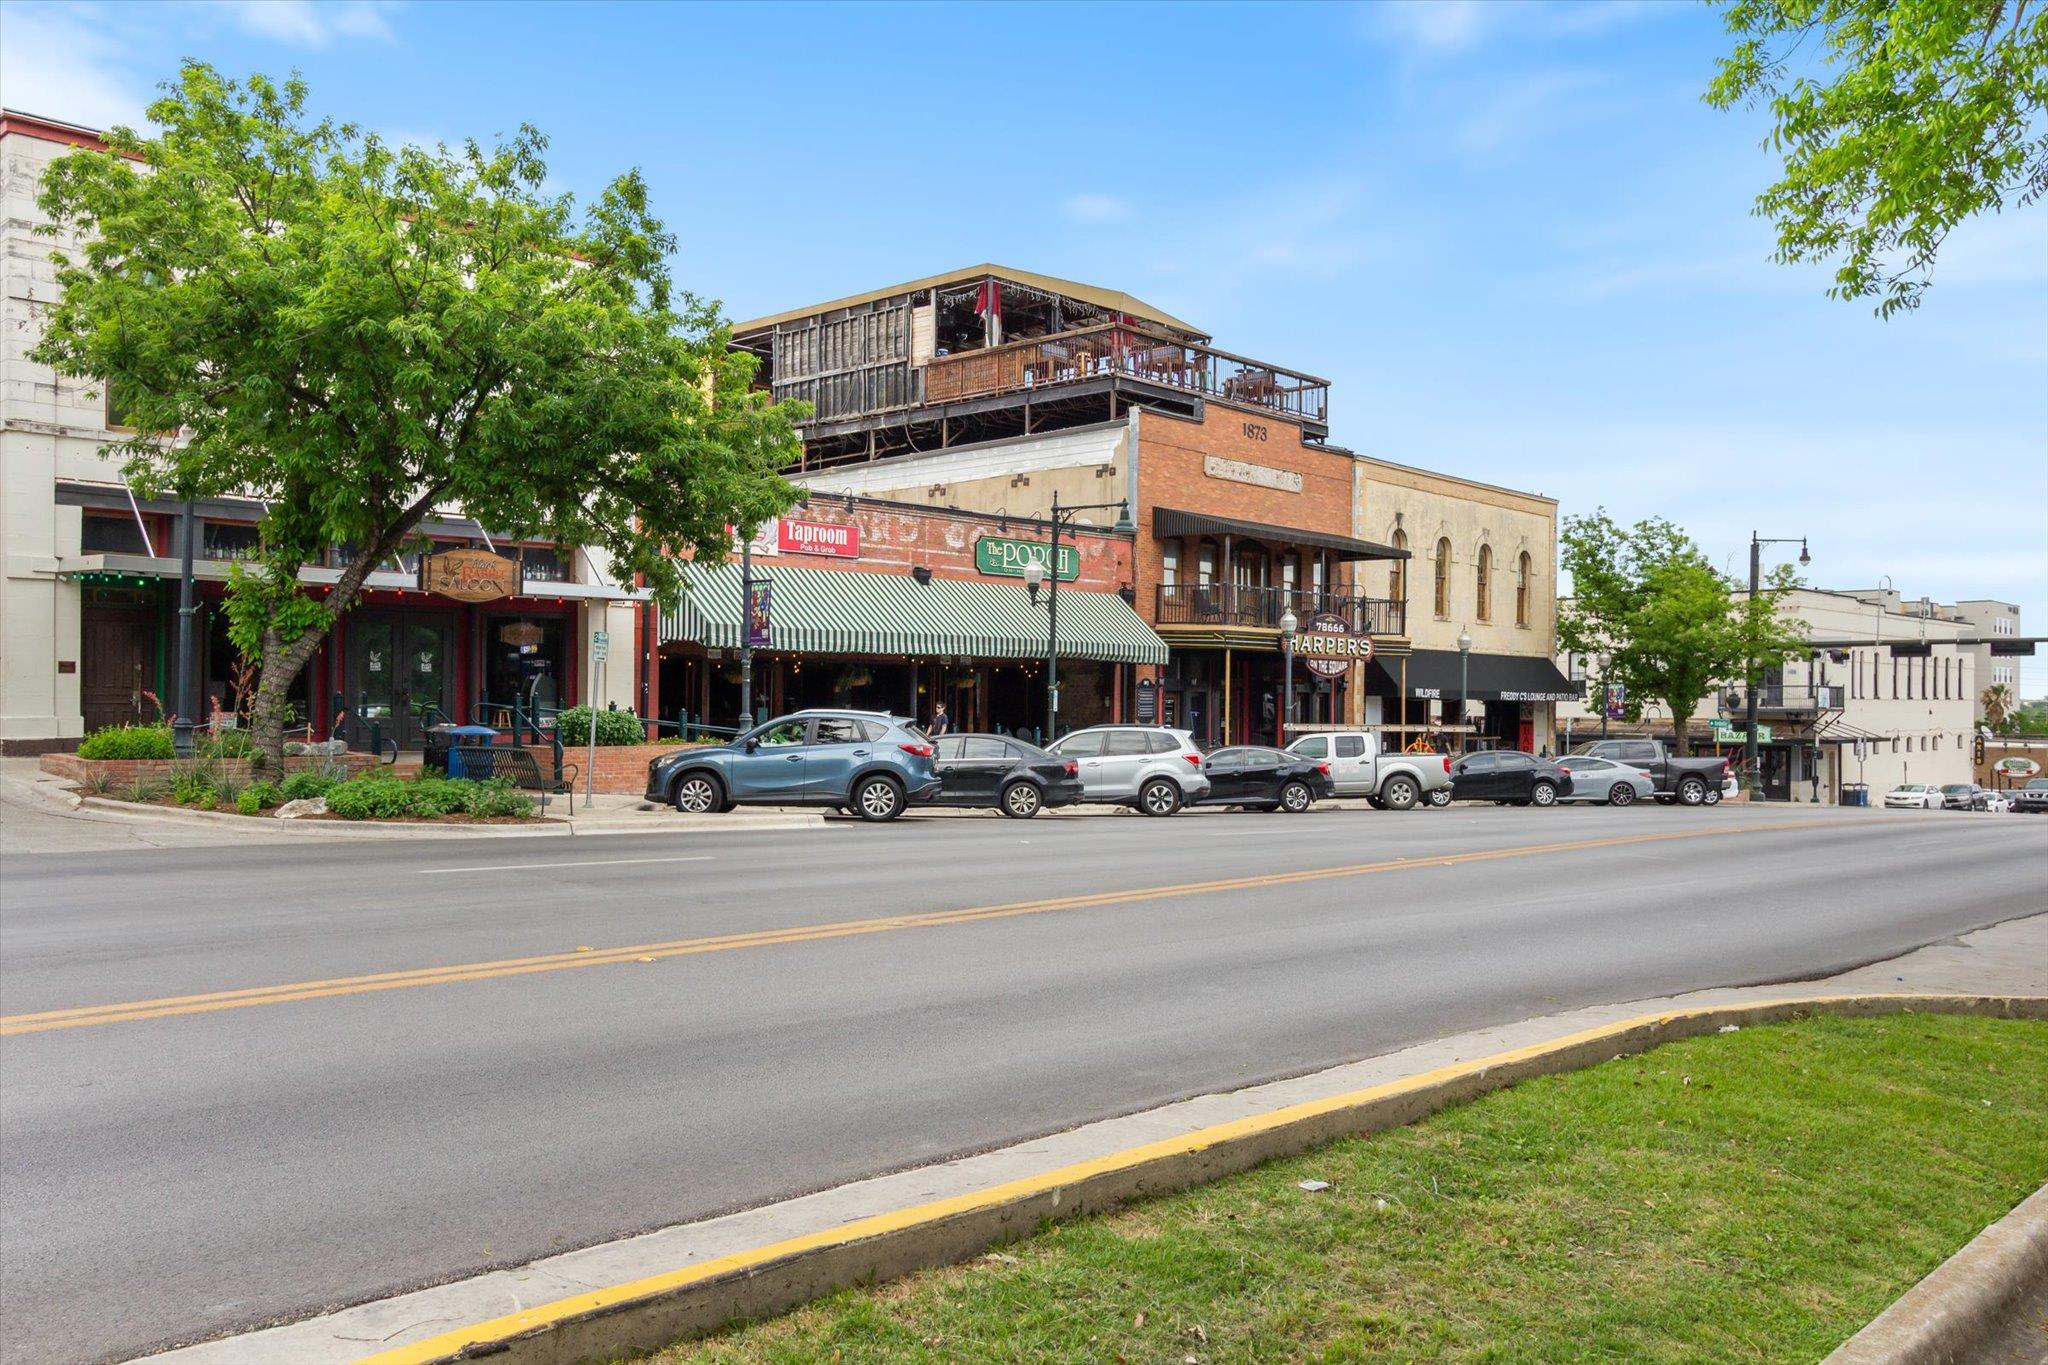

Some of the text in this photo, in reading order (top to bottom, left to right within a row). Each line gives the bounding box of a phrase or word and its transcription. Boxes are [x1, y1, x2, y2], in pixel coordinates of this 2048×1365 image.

[1242, 422, 1268, 442] 1873
[786, 521, 848, 546] Taproom
[800, 544, 813, 552] Pub
[820, 545, 836, 554] Grub
[986, 541, 1003, 556] The
[439, 575, 505, 594] SALOON
[1316, 622, 1345, 633] 78666
[1290, 635, 1372, 656] HARPER'S
[1310, 660, 1348, 674] ON THE SQUARE
[1415, 688, 1440, 698] WILDFIRE
[1500, 691, 1579, 701] FREDDY C'S LOUNGE AND PATIO BAR
